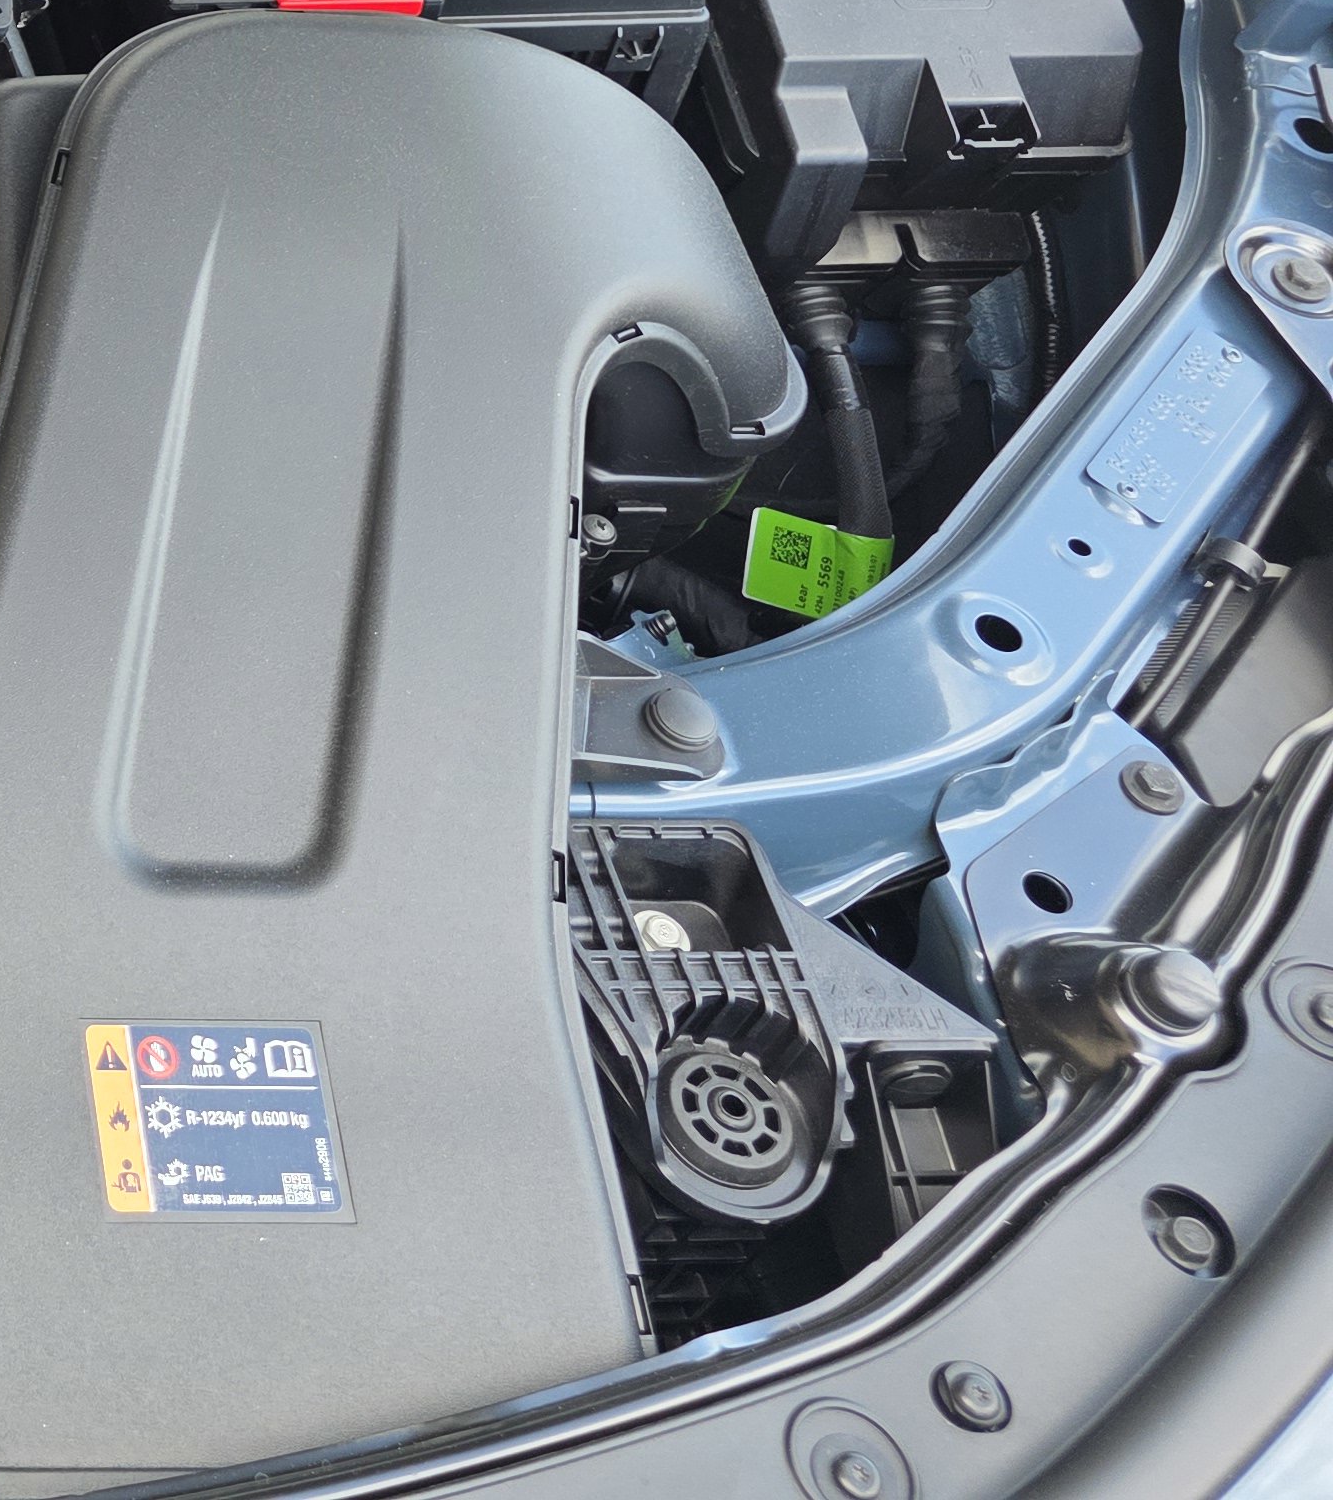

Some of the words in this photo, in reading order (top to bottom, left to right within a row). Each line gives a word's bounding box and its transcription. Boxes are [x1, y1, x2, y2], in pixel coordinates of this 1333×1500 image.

[817, 556, 833, 589] 5569
[795, 584, 808, 609] Lear
[191, 1064, 223, 1078] AUTO
[185, 1110, 246, 1130] R-1234yf
[251, 1111, 289, 1125] 0.600
[290, 1111, 310, 1129] kg
[195, 1165, 226, 1182] PAG
